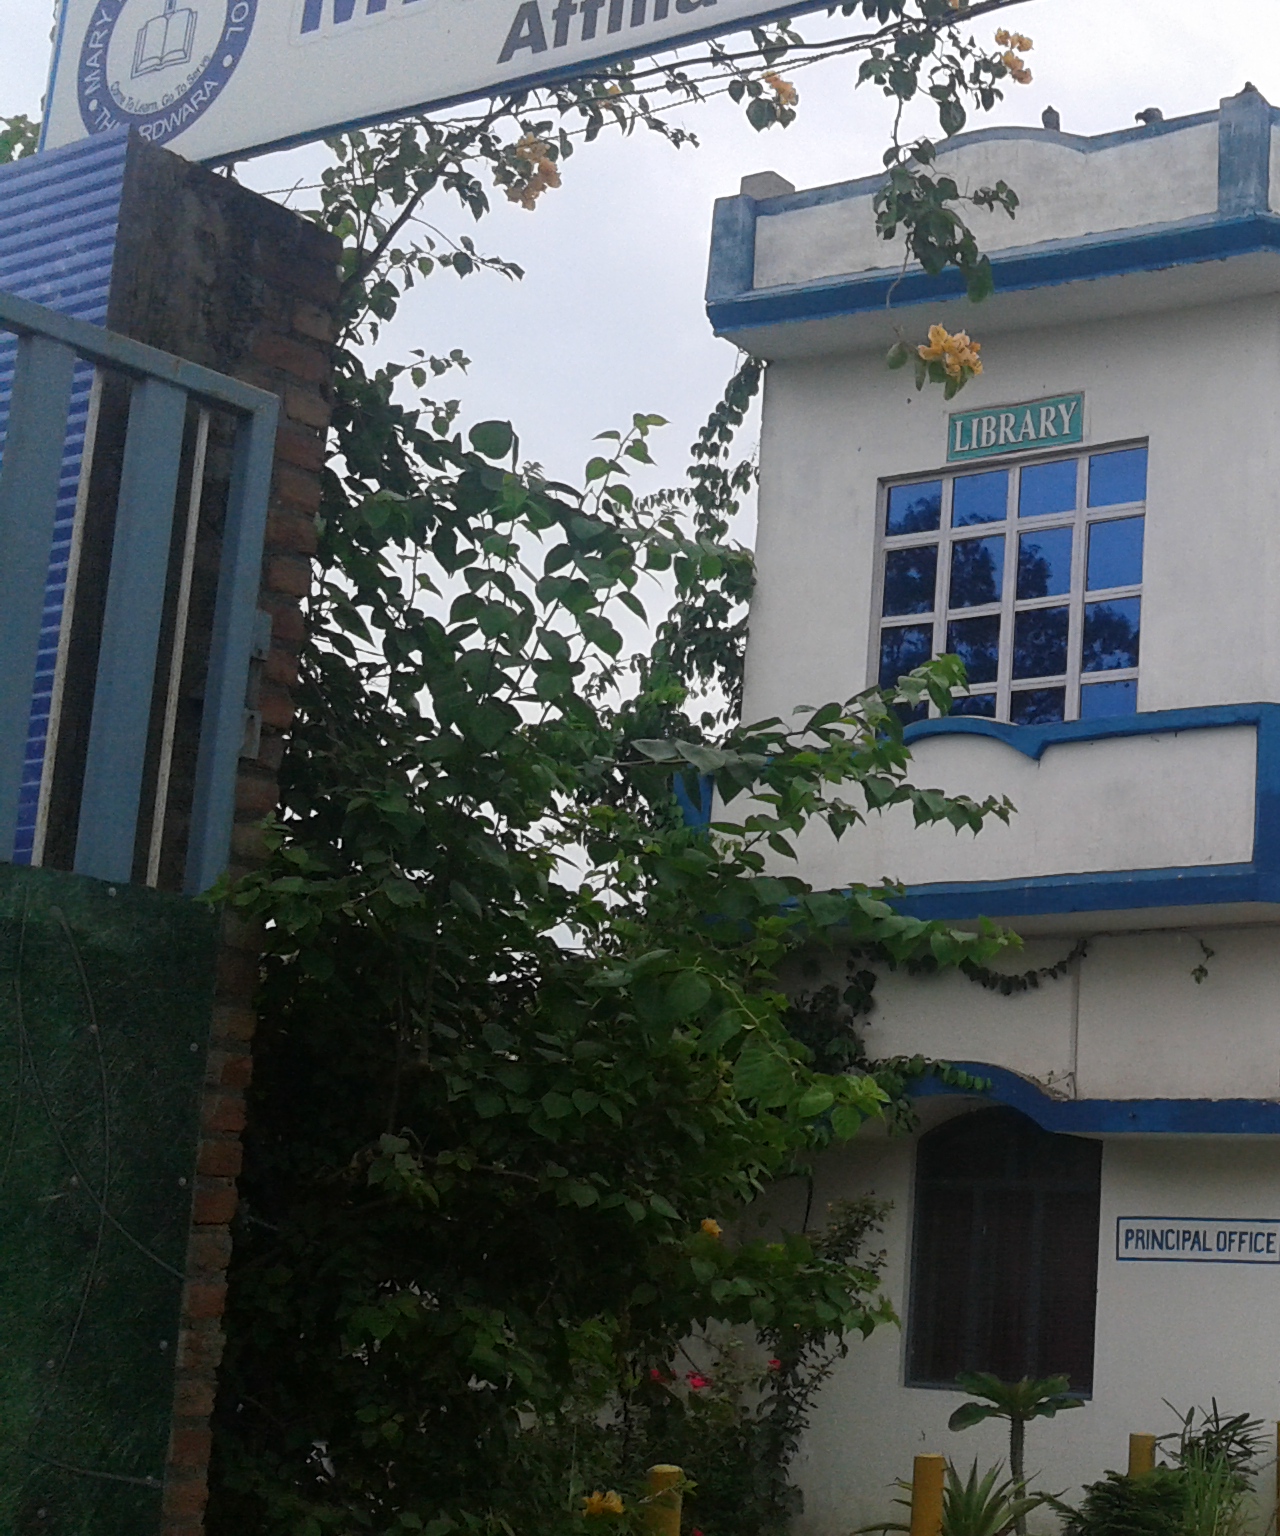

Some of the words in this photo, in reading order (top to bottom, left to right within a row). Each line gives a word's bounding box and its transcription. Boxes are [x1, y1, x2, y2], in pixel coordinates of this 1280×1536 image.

[84, 9, 112, 96] MARY
[225, 0, 249, 41] OL
[162, 93, 175, 106] Go
[175, 83, 187, 96] To
[954, 401, 1078, 453] LIBRARY
[1124, 1229, 1213, 1252] PRINCIPAL
[1216, 1231, 1278, 1254] OFFICE
